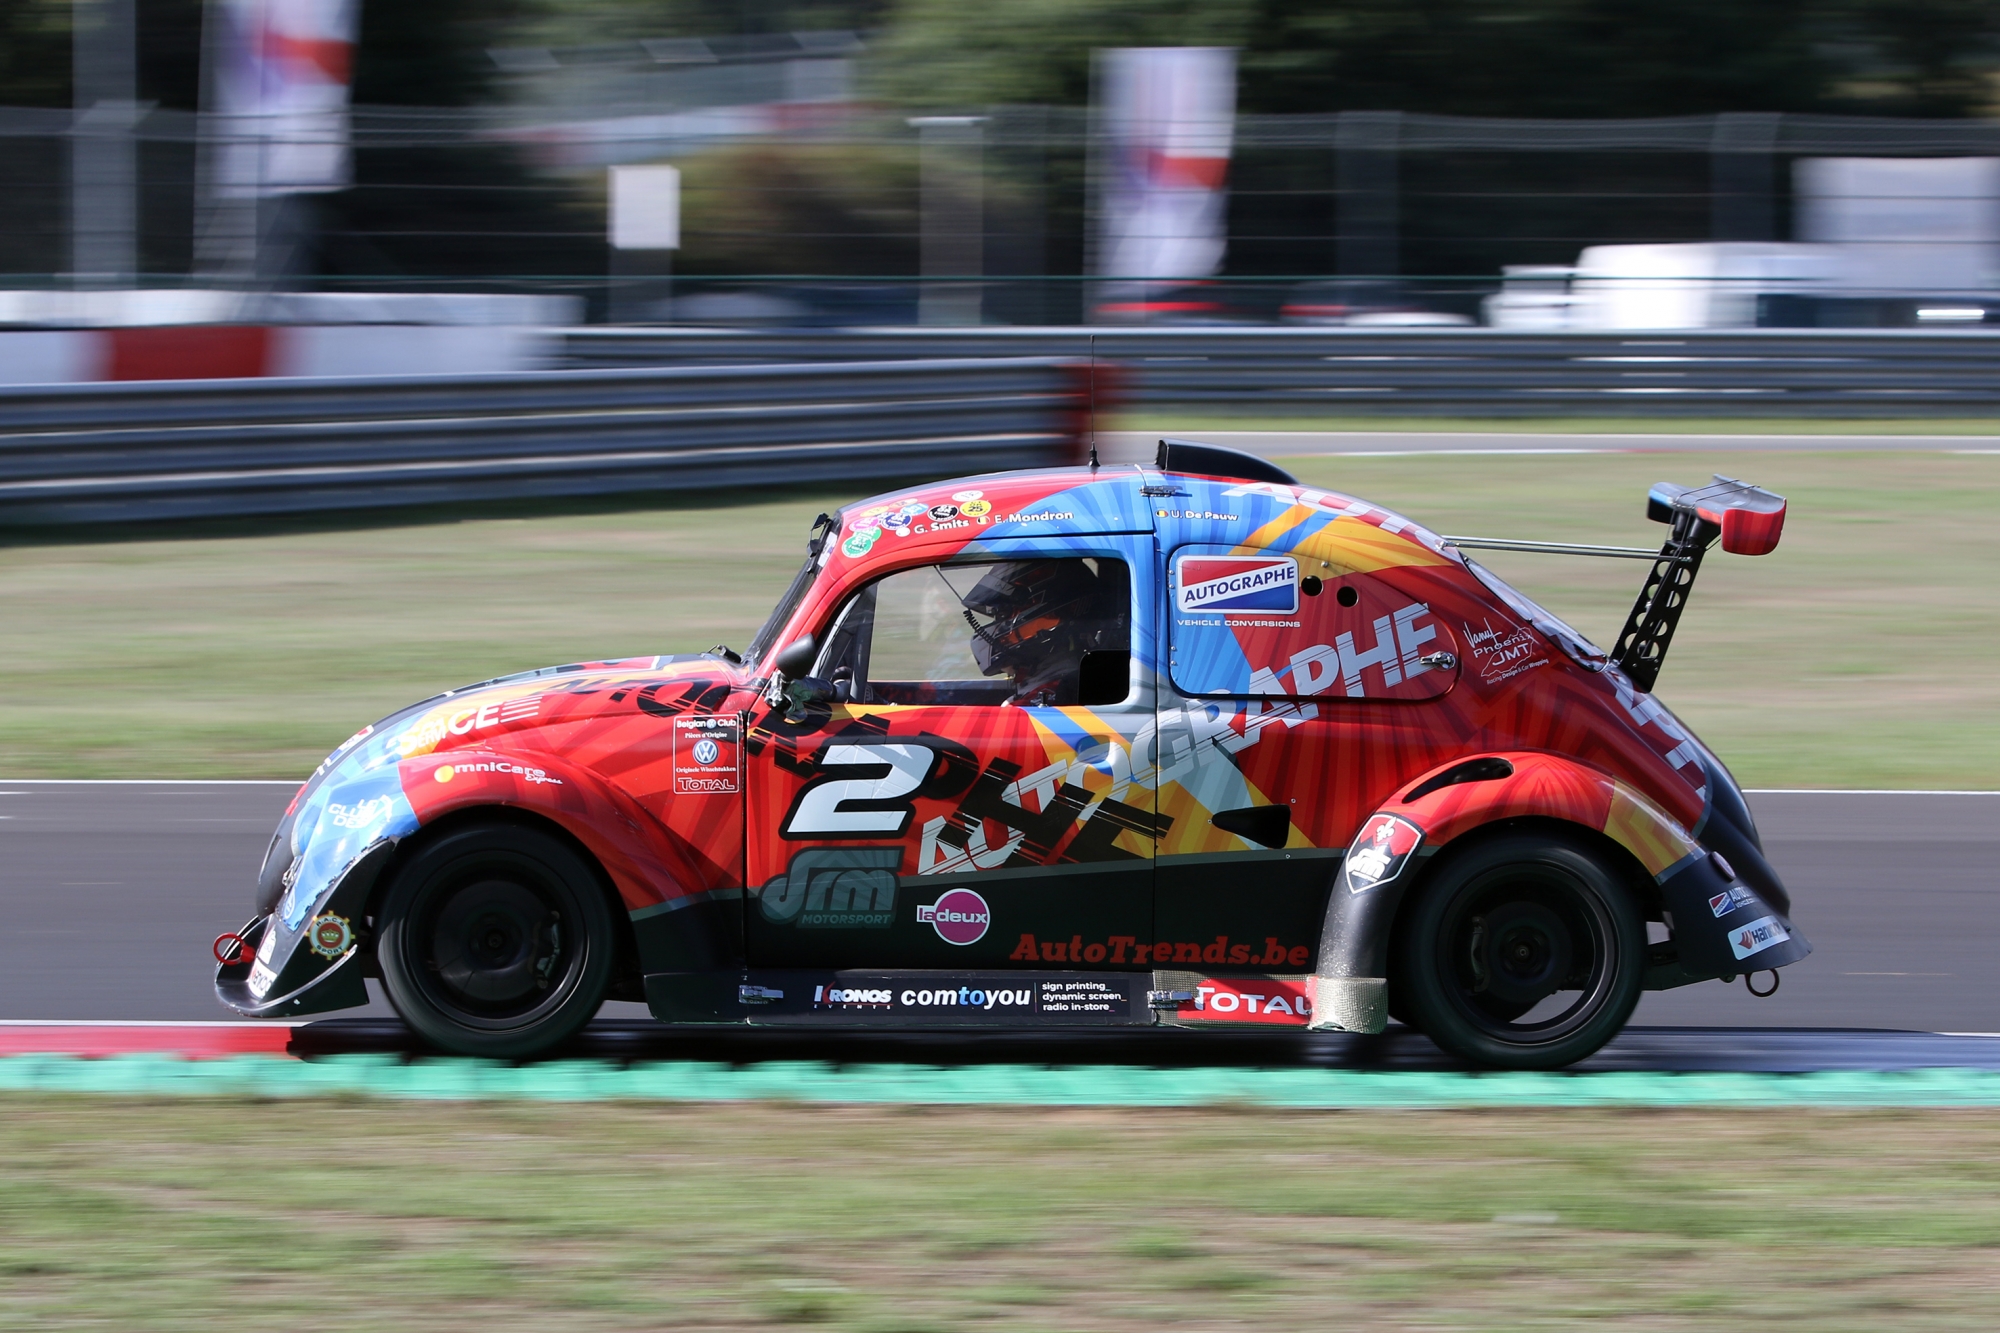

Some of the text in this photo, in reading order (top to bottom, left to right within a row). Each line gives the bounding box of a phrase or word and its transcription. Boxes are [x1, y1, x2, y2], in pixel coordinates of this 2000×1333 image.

[995, 510, 1074, 524] E. Mondron
[1171, 510, 1239, 522] U. De Pauw
[914, 519, 970, 533] G. Smits
[1184, 566, 1295, 603] AUTOGRAPHE
[1224, 620, 1301, 628] CONVERSIONS
[1492, 643, 1529, 666] JMT
[1502, 669, 1519, 679] Design
[676, 720, 706, 730] Belgian
[717, 719, 737, 727] Club
[678, 777, 735, 791] TOTAL
[787, 744, 934, 832] 2
[802, 914, 891, 924] MOTORSPORT
[316, 944, 343, 955] SPORT
[1009, 933, 1309, 966] AutoTrends.be
[814, 981, 892, 1003] KRONOS
[1042, 982, 1063, 991] sign
[900, 986, 1031, 1009] comtoyou
[1042, 992, 1086, 1002] dynamic
[1043, 1002, 1069, 1011] radio
